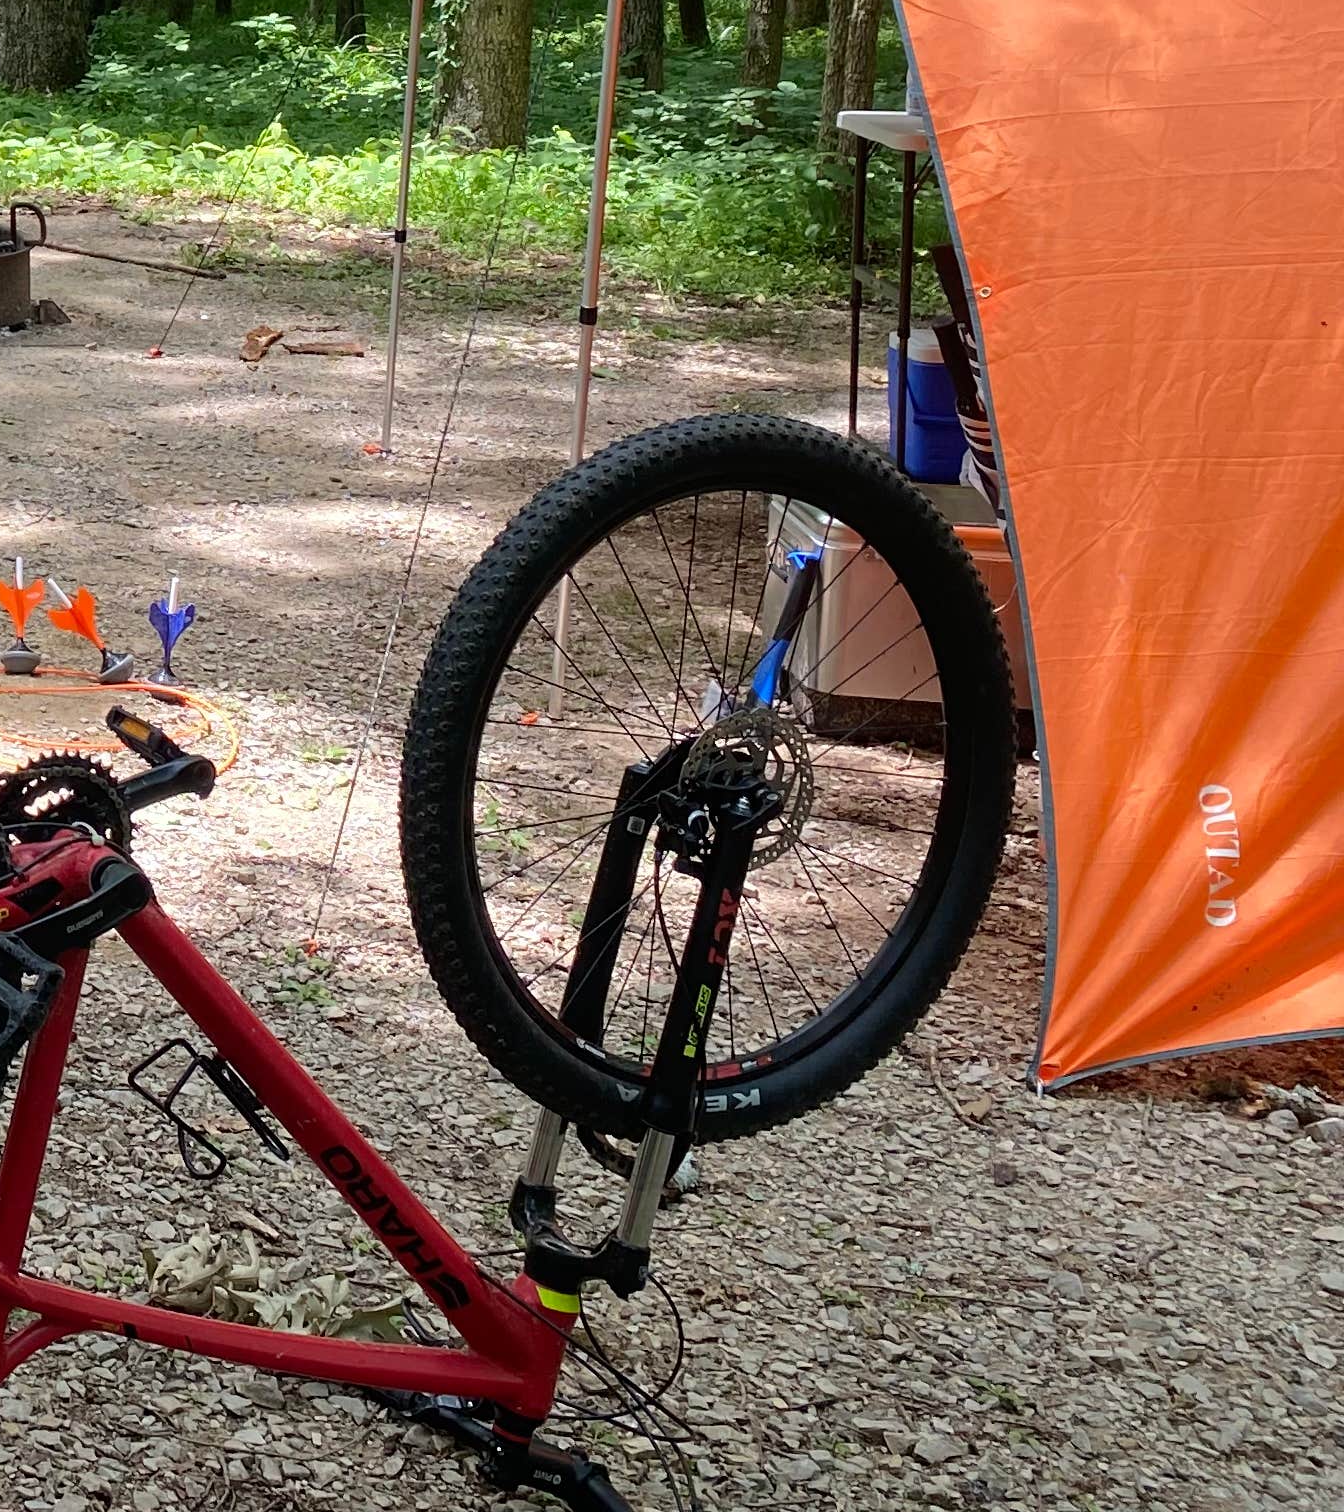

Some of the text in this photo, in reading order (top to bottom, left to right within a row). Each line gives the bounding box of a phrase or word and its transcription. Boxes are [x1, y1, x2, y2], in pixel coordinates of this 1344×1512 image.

[1199, 784, 1241, 927] OUTAD
[615, 1083, 762, 1113] KEA
[321, 1145, 443, 1274] HARO
